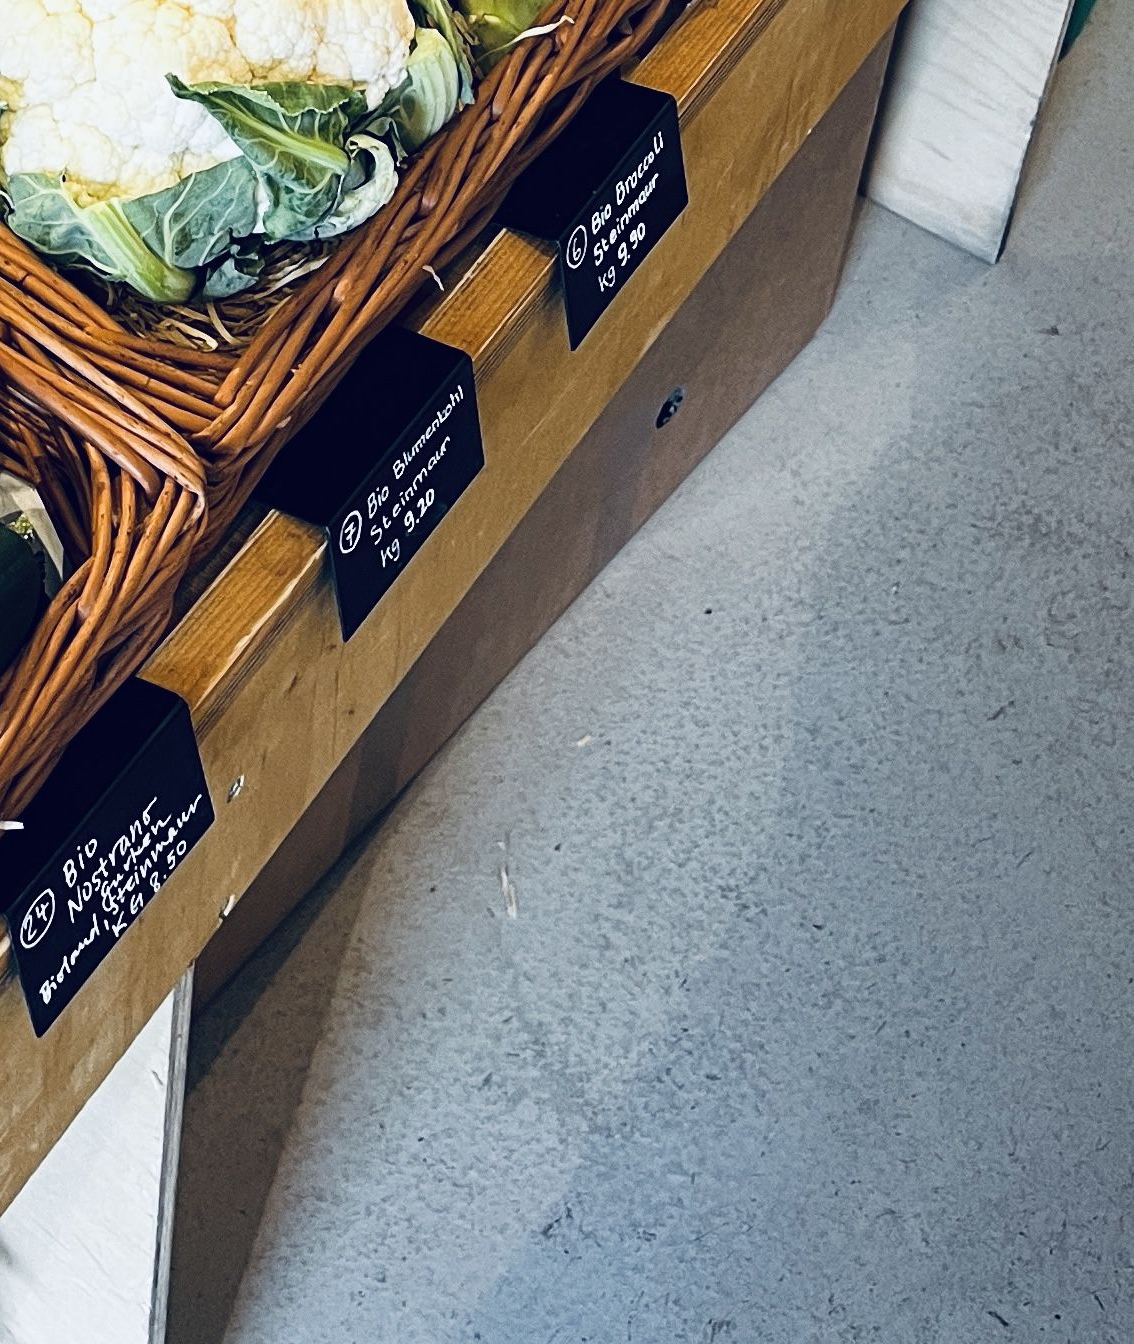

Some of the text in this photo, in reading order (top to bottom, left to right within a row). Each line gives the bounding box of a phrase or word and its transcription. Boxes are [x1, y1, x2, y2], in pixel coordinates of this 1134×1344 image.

[591, 203, 612, 235] Bio
[615, 131, 664, 206] Broccoli
[593, 173, 659, 266] Steinmaur
[367, 485, 390, 519] Bio
[392, 384, 464, 480] Blumenkohl
[370, 435, 451, 546] Steinmaur
[403, 487, 436, 534] 9.20
[62, 838, 99, 888] Bio
[68, 796, 158, 923] Nostrano
[110, 793, 202, 915] Steinmaur
[148, 839, 187, 894] 8.50
